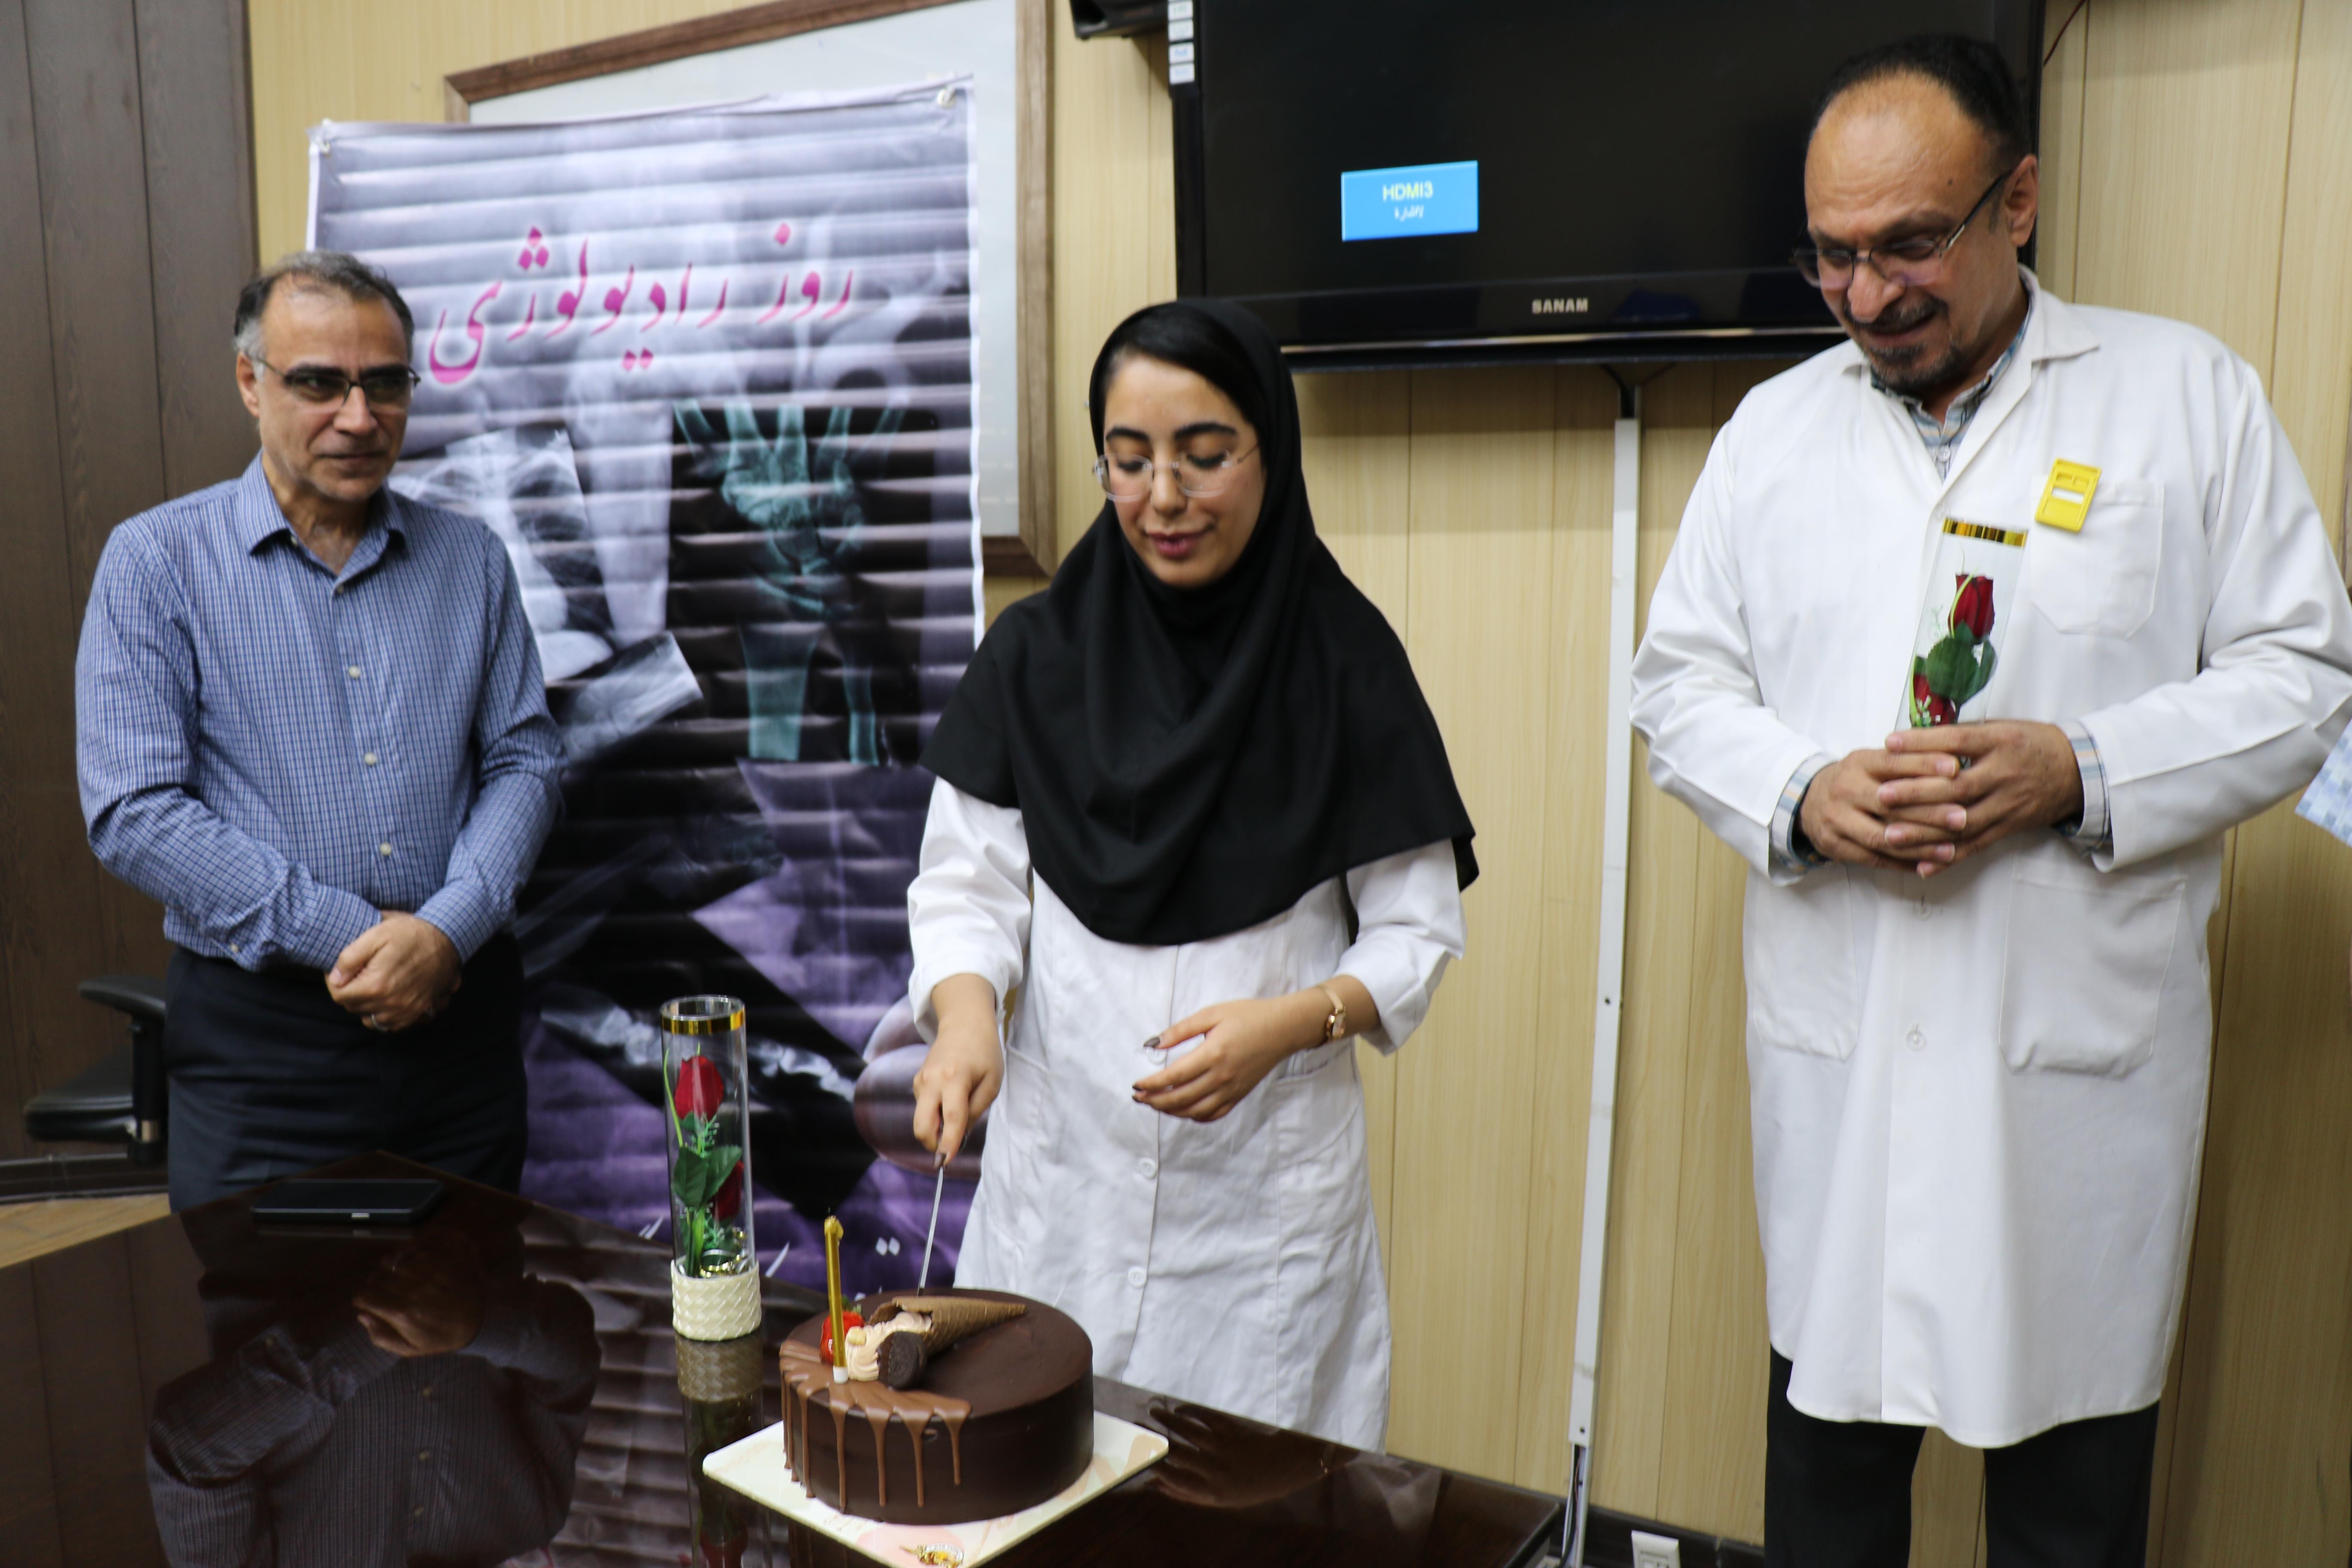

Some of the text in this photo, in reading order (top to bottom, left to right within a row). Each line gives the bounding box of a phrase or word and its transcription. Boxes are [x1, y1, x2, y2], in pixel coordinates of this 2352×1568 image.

[1382, 181, 1433, 202] HDMI3
[430, 223, 853, 384] روز رادیولوژی
[1532, 298, 1588, 314] SANAM
